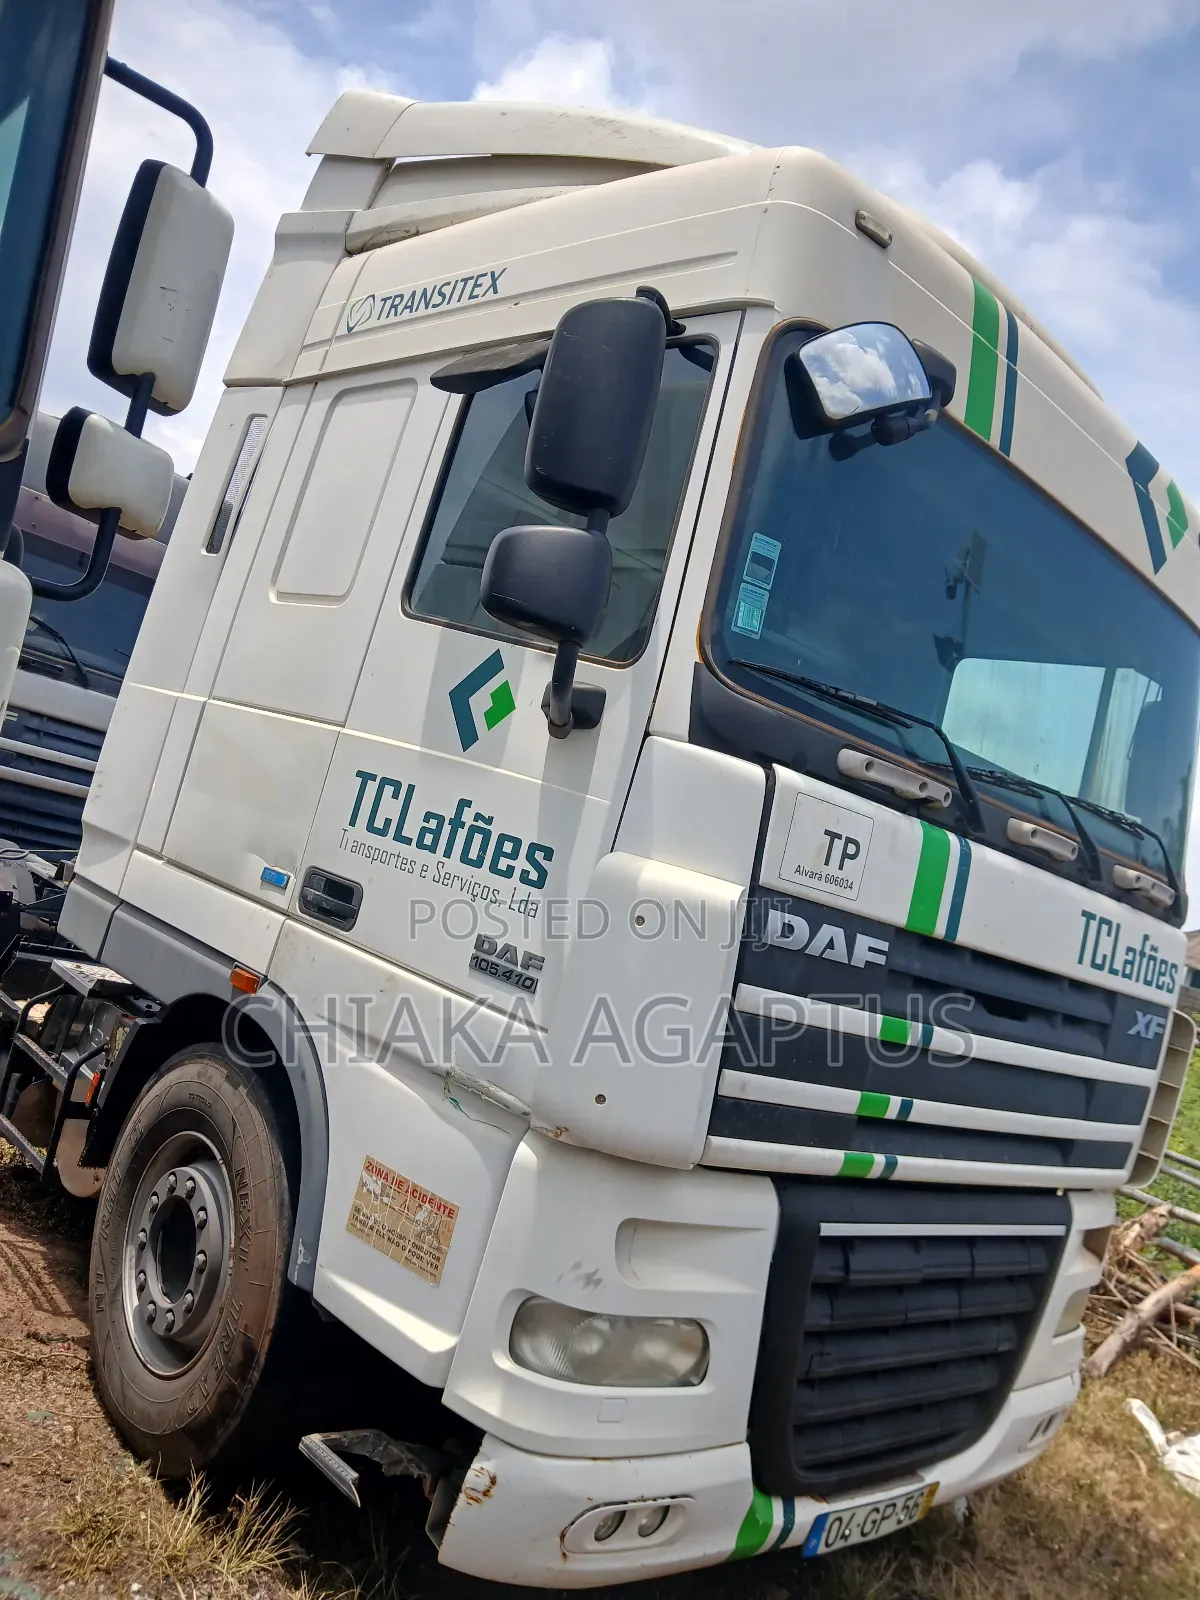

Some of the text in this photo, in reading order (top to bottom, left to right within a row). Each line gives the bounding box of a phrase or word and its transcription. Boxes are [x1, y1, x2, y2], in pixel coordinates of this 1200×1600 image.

[377, 267, 508, 321] TRANSITEX
[348, 769, 555, 890] TCLafões
[823, 828, 861, 871] TP
[419, 863, 429, 879] e
[508, 887, 540, 919] Lda
[794, 864, 854, 891] Alvará 606034
[474, 932, 546, 971] DAF
[762, 908, 890, 969] DAF
[1077, 908, 1179, 995] TCLafões
[471, 955, 537, 991] 105.410
[1126, 1010, 1167, 1040] XF
[365, 1161, 389, 1183] ZONA
[405, 1184, 456, 1219] ACIDENTE
